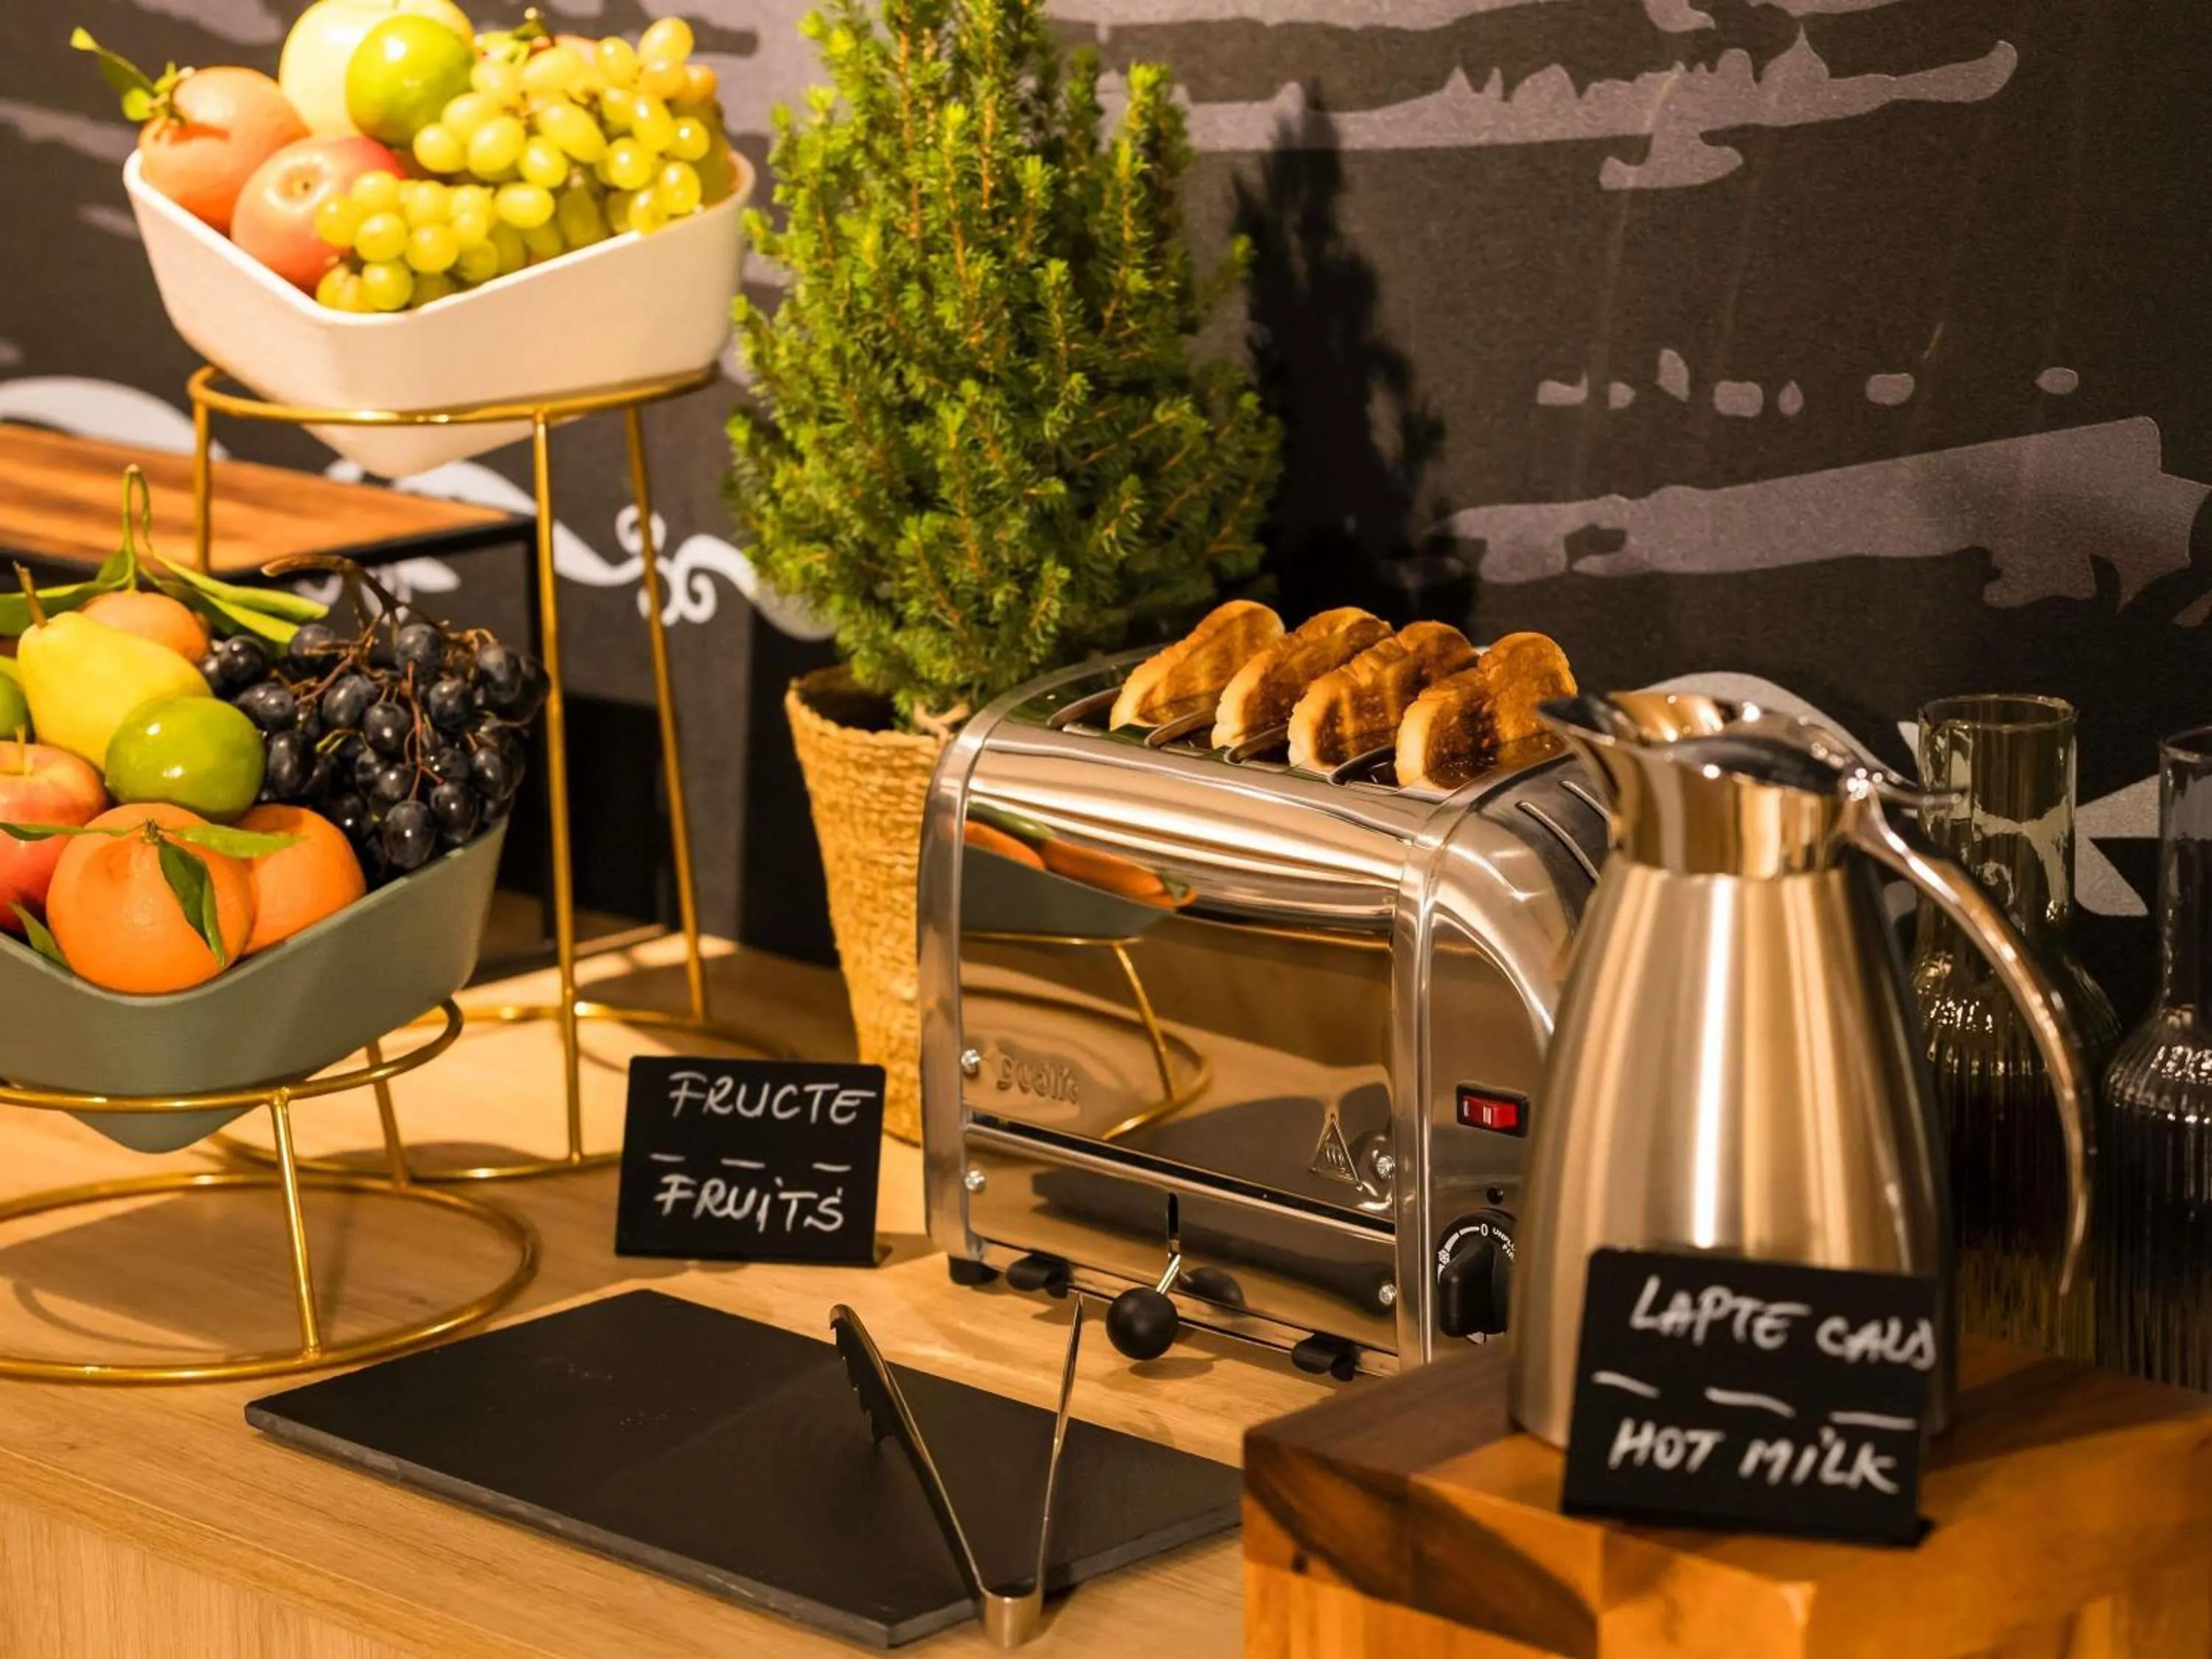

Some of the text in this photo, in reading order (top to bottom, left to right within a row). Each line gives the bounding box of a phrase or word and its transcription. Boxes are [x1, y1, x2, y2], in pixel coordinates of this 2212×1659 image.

[669, 1071, 877, 1125] FRUCTE
[1630, 1275, 1812, 1349] LAPTE
[1608, 1417, 1724, 1472] HOT
